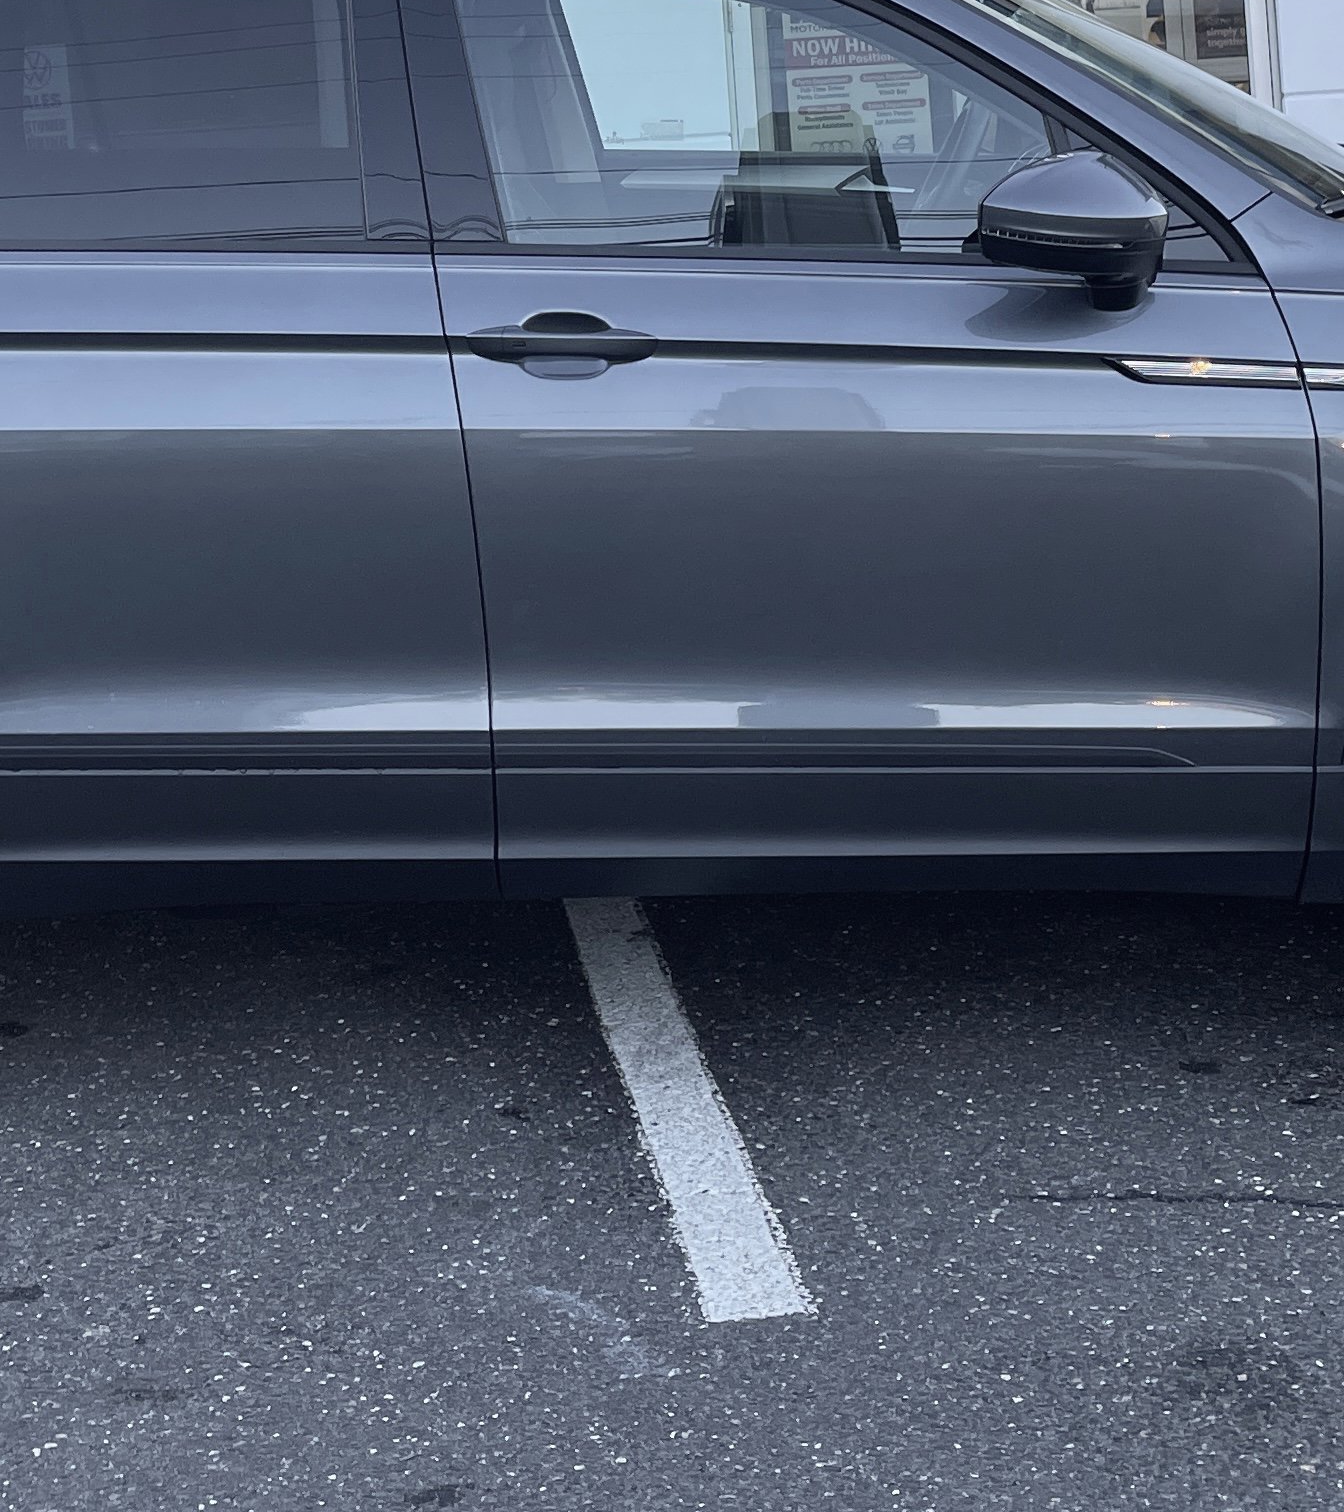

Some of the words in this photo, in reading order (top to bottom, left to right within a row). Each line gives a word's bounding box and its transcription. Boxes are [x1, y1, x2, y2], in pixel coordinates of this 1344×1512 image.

[792, 38, 840, 57] NOW
[810, 56, 829, 66] For
[831, 55, 846, 65] All
[797, 123, 821, 131] General
